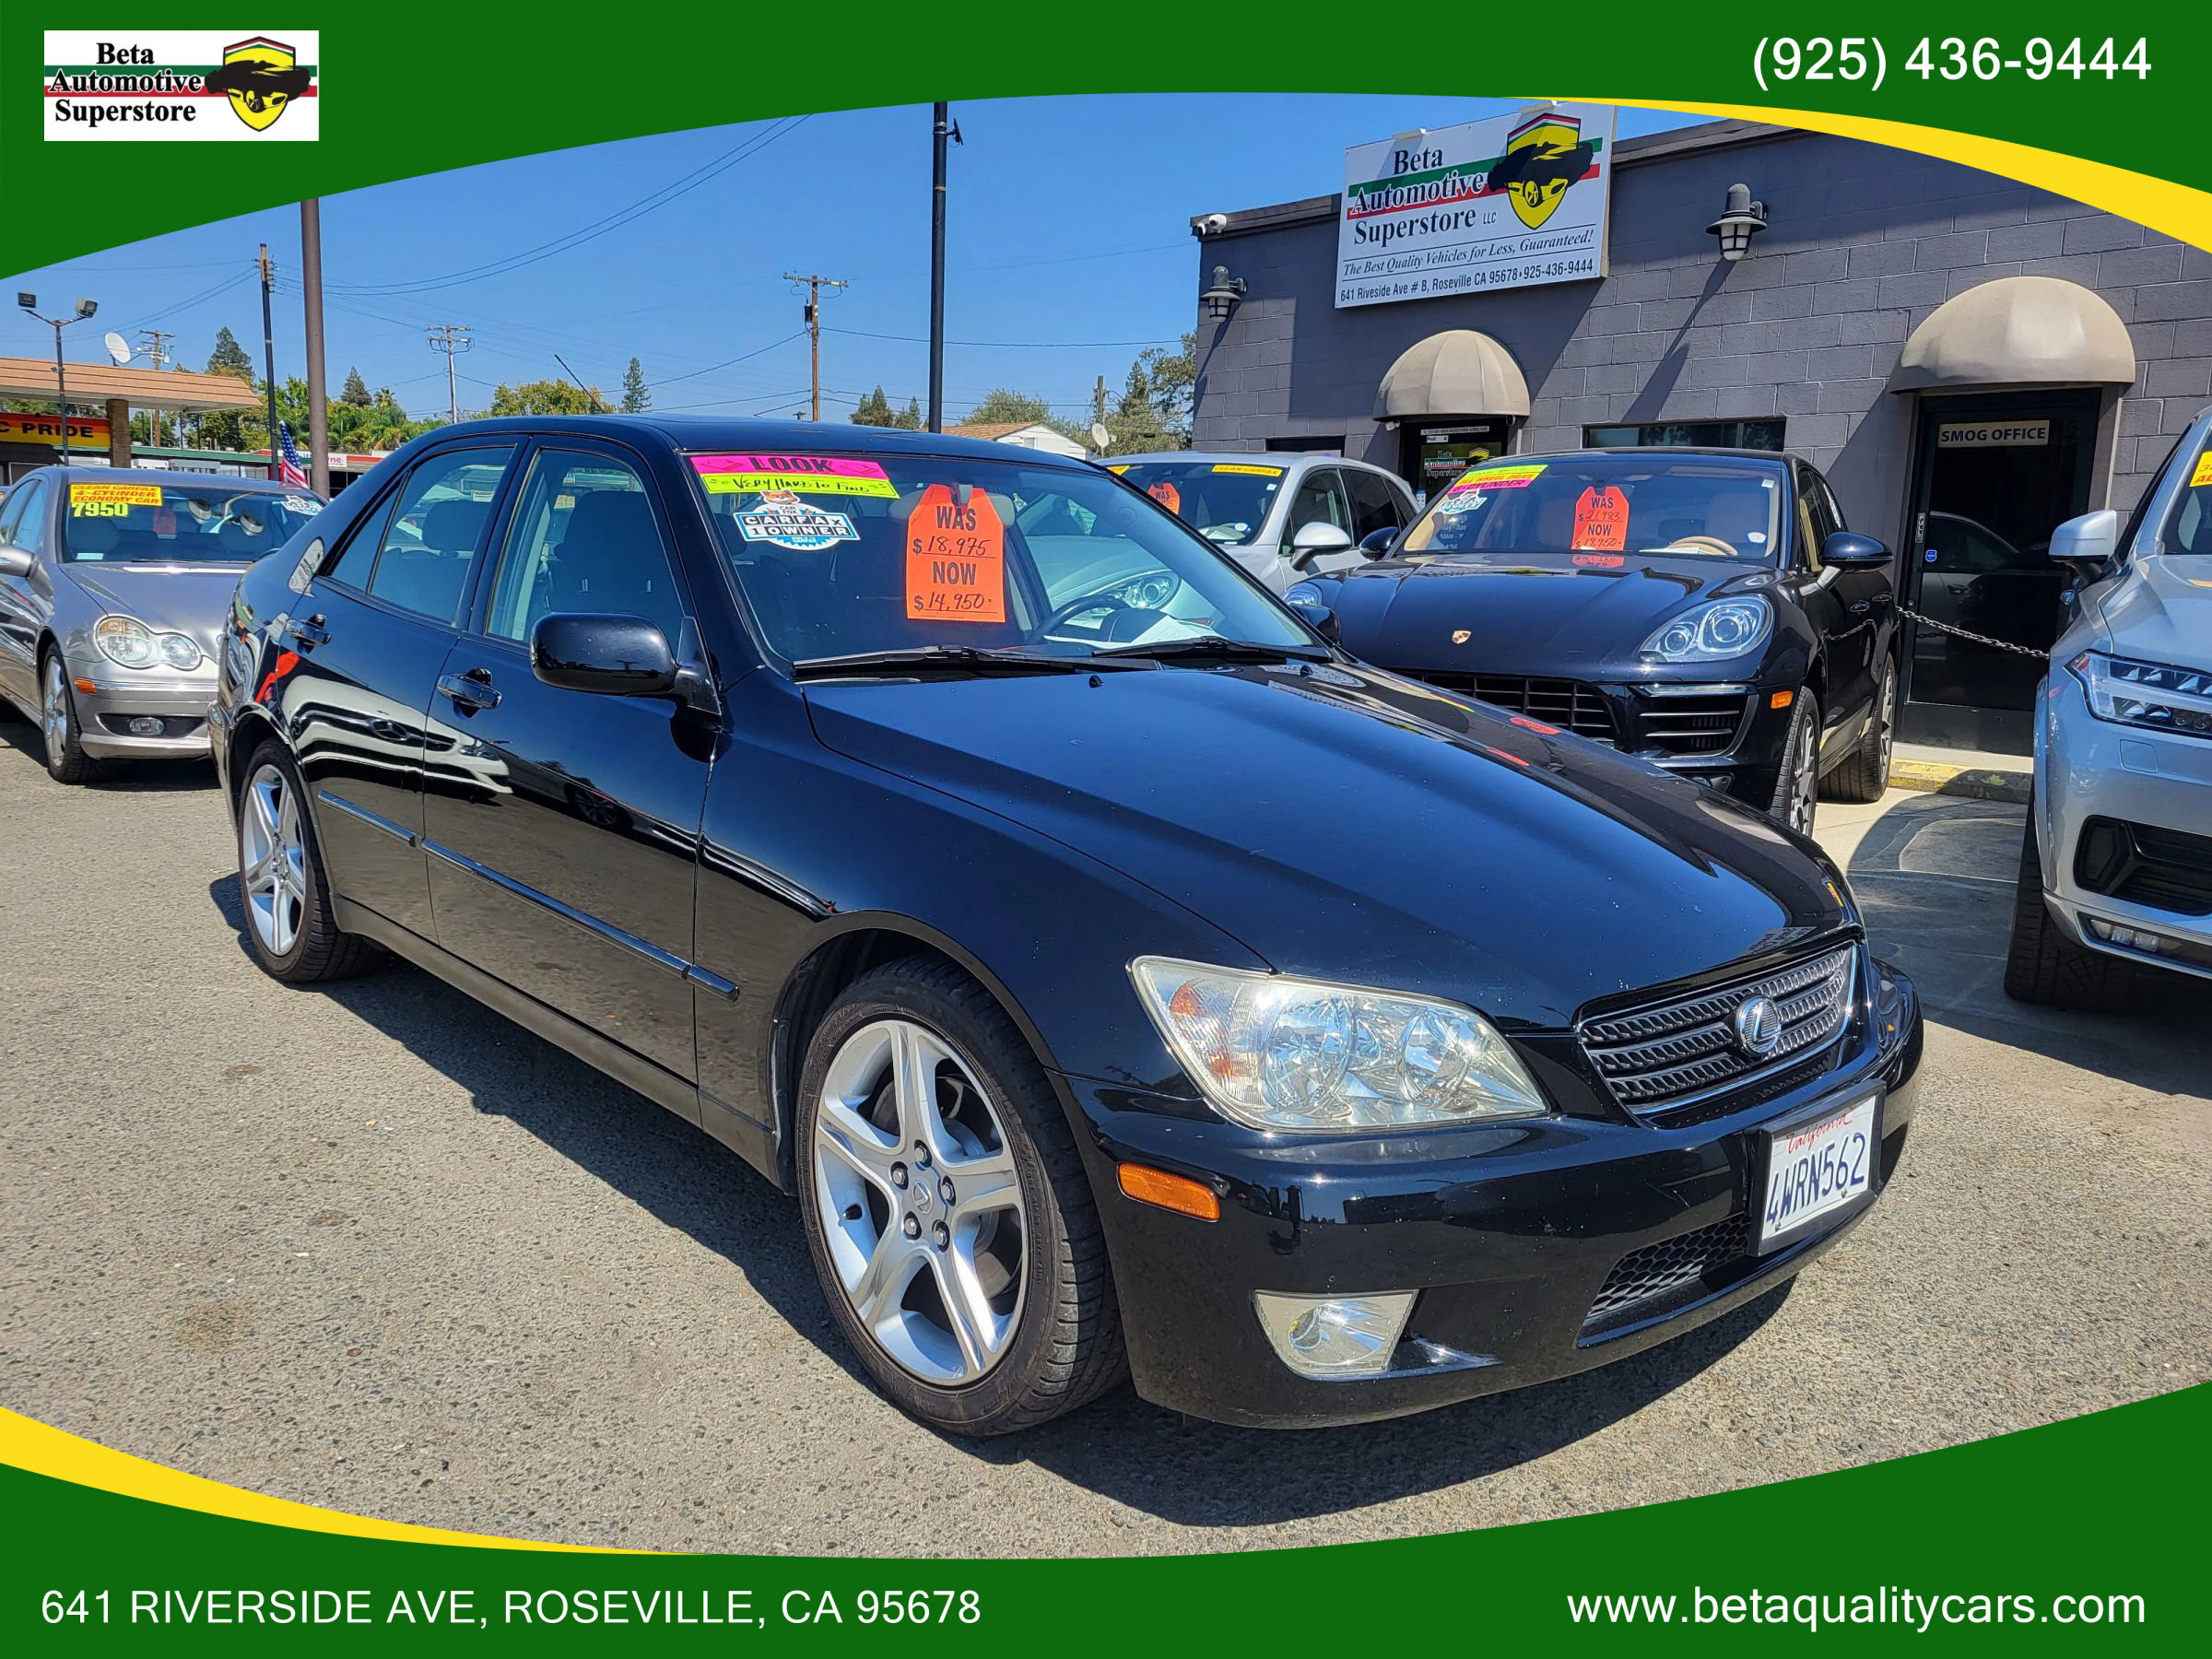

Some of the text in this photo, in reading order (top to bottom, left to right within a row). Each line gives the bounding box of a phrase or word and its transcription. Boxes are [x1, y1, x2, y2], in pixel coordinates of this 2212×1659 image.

[1394, 147, 1443, 175] Beta
[1351, 171, 1485, 215] Automotive
[1353, 209, 1497, 248] Superstore LLC
[1344, 229, 1594, 276] The Best Quality Vehicles for Less, Guaranteed!
[1341, 288, 1354, 301] 641
[1394, 283, 1408, 295] Ave
[1411, 281, 1418, 293] #
[1432, 275, 1472, 290] Roseville
[1475, 273, 1487, 286] CA
[22, 422, 94, 438] PRIDE
[1941, 427, 2046, 442] SMOG OFFICE
[747, 456, 835, 473] LOOK
[72, 502, 129, 517] 7950
[1592, 498, 1614, 509] WAS
[744, 515, 841, 526] CARFAX
[936, 506, 977, 531] WAS
[767, 527, 852, 536] OWNER
[1587, 524, 1612, 535] NOW
[912, 535, 993, 556] $ 18,975
[933, 560, 977, 585] NOW
[913, 594, 924, 611] $
[1766, 1132, 1865, 1225] 4WRN562
